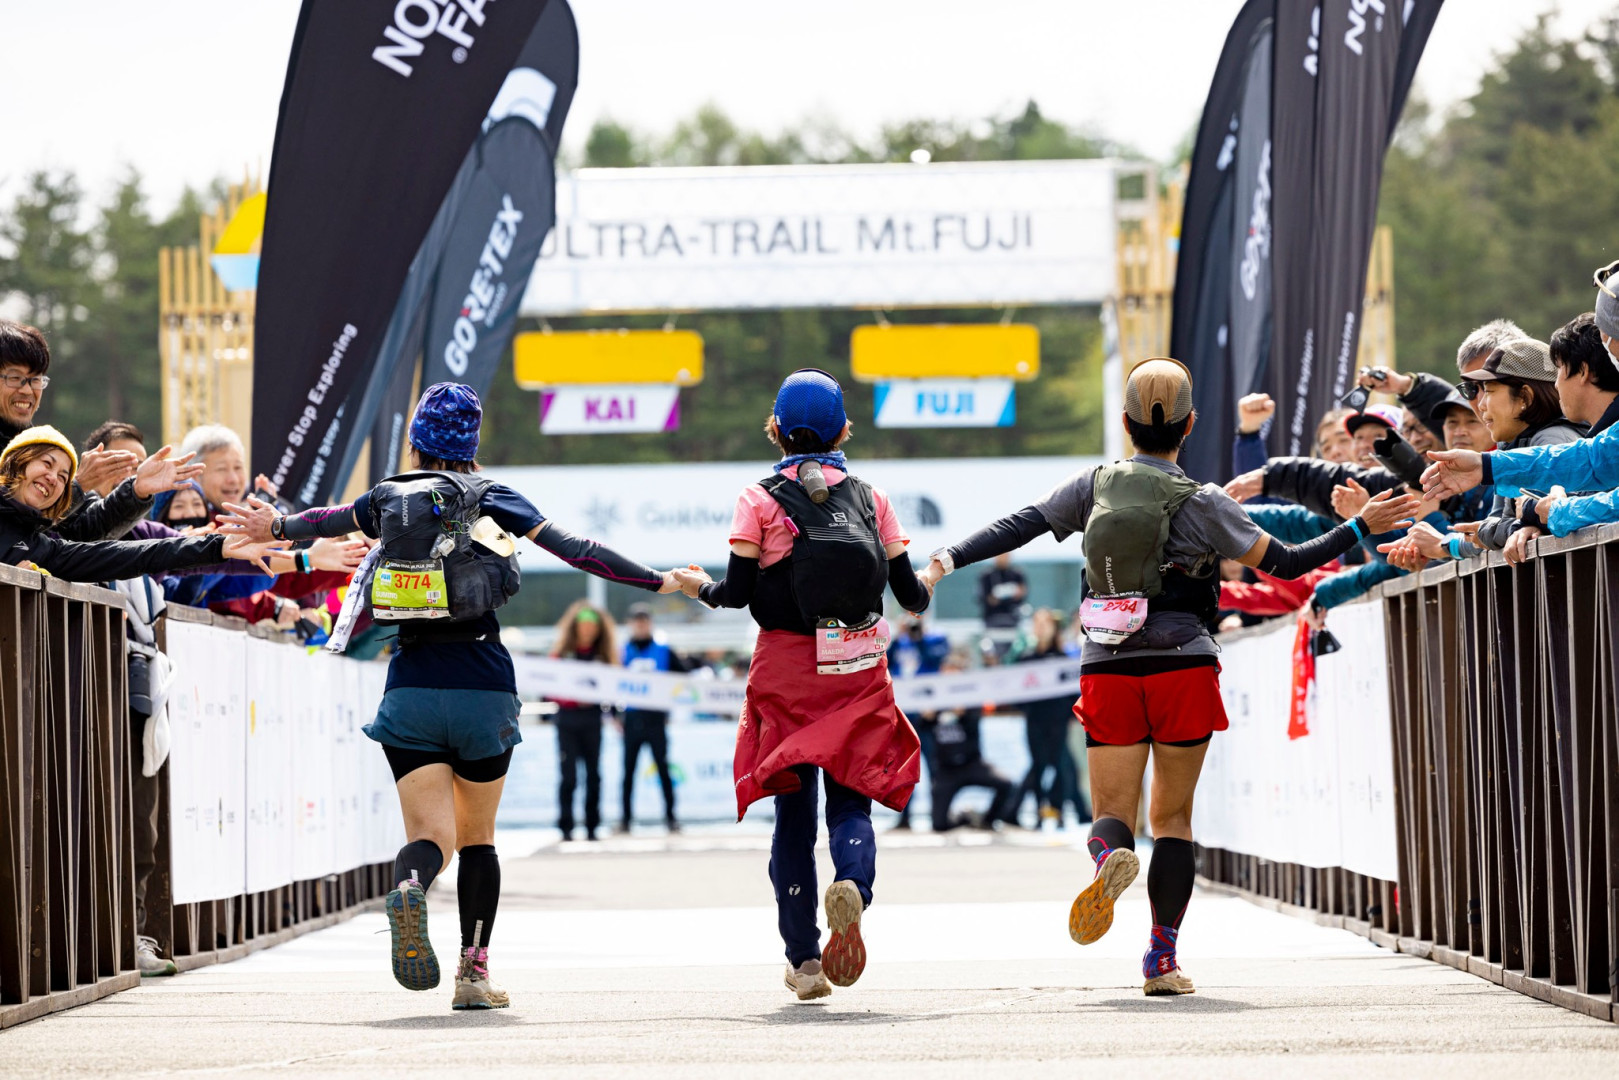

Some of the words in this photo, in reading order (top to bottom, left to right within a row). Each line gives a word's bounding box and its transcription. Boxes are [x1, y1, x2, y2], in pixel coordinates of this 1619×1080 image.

[371, 0, 450, 78] NO
[857, 213, 1033, 253] Mt.FUJI
[444, 193, 524, 377] GORE-TEX
[272, 446, 296, 492] ever
[288, 404, 318, 447] Stop
[307, 322, 359, 406] Exploring
[583, 397, 637, 422] KAI
[915, 390, 975, 416] FUJI
[394, 573, 431, 589] 3774
